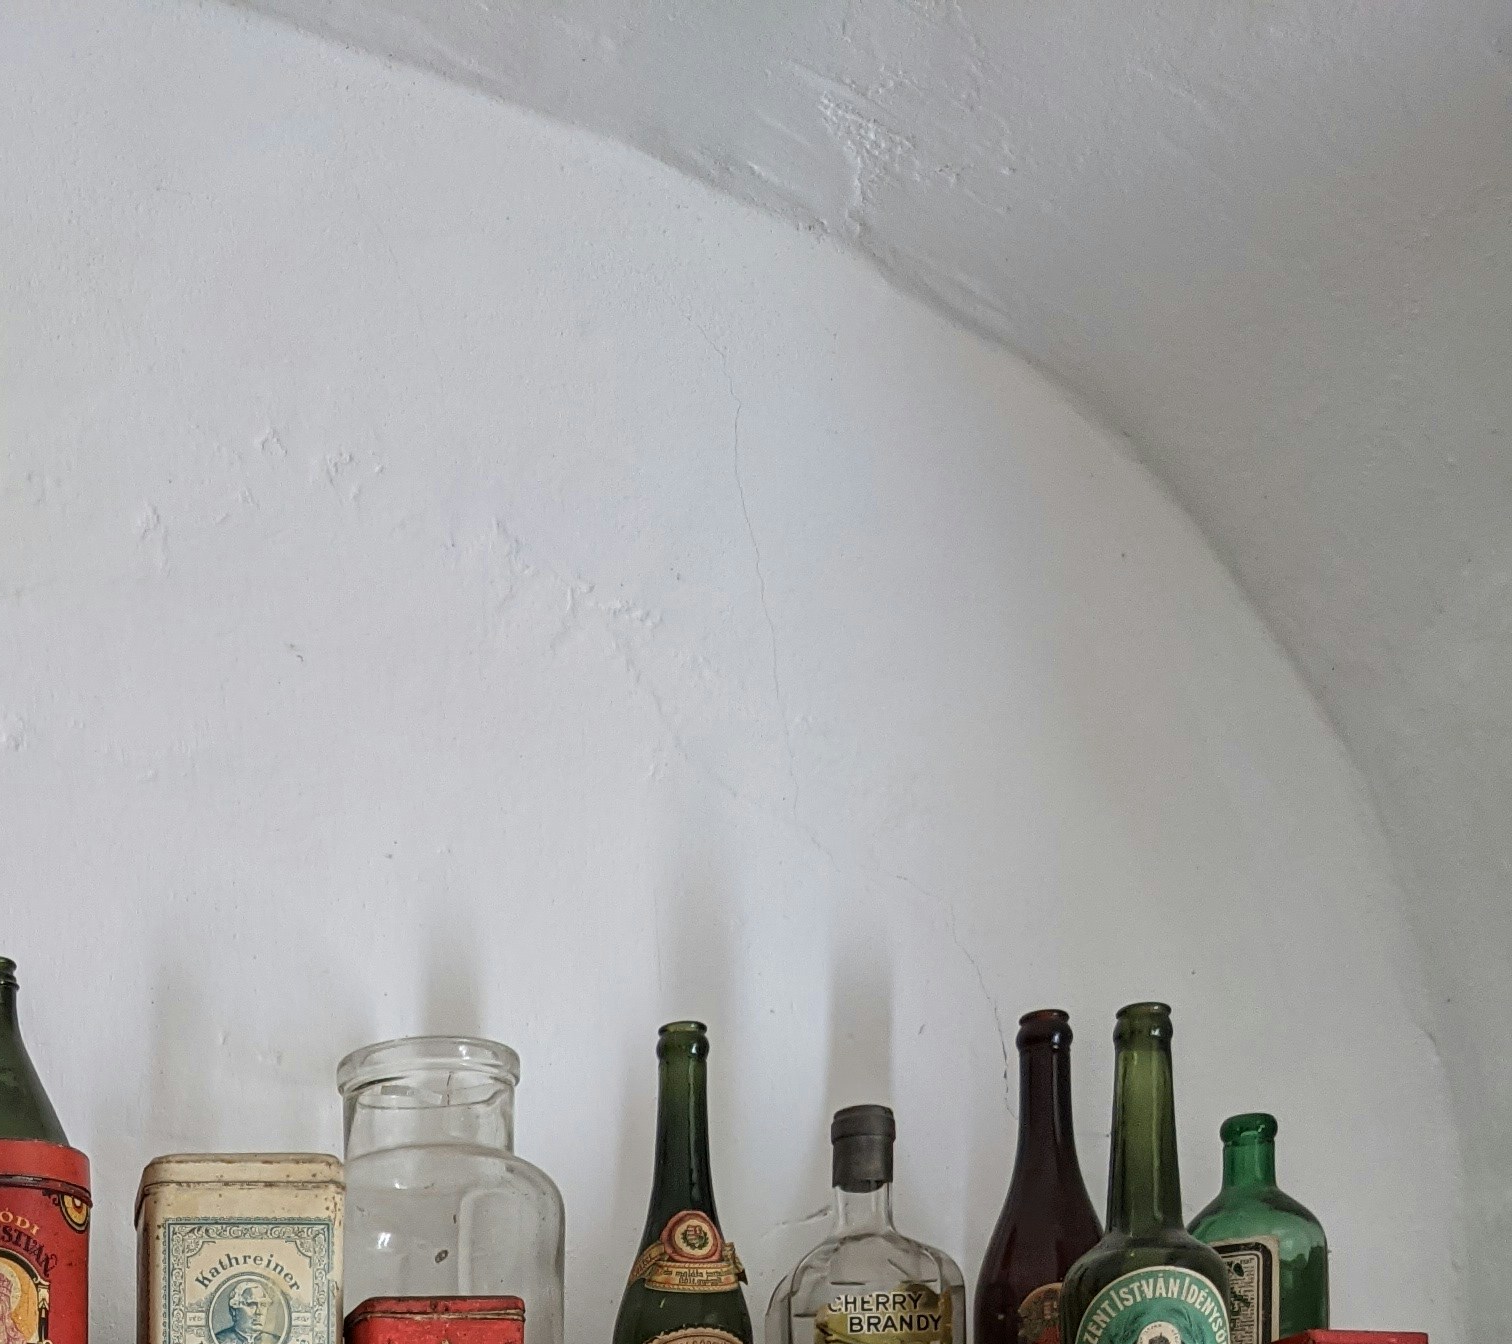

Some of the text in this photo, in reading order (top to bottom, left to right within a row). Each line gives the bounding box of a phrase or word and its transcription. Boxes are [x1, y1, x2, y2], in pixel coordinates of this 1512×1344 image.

[194, 1253, 300, 1291] Kathreiner
[827, 1292, 923, 1313] CHERRY
[1109, 1273, 1181, 1311] ISTVÁN
[848, 1314, 943, 1334] BRANDY
